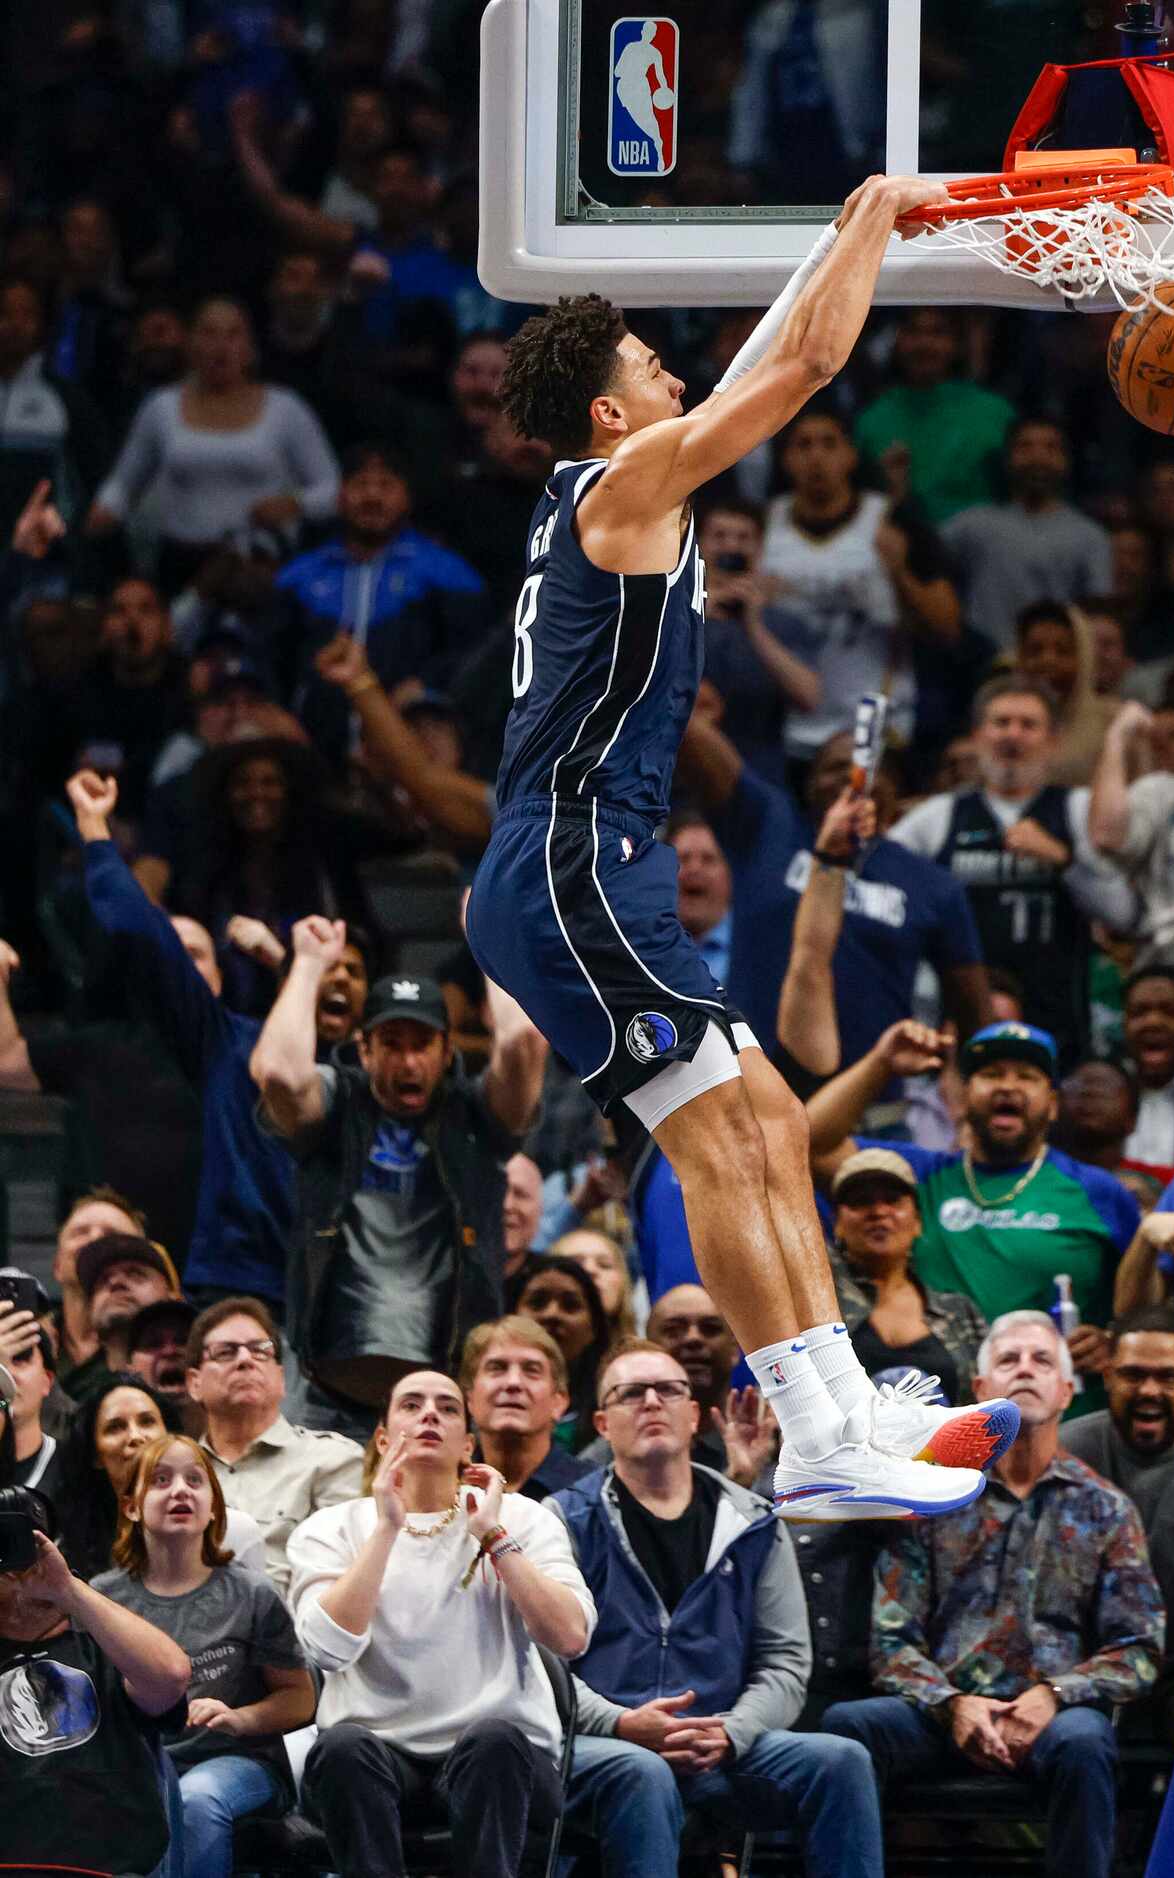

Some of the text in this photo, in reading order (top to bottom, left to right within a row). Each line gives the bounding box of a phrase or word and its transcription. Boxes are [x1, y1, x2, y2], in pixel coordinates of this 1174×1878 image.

[618, 140, 650, 165] NBA
[512, 574, 544, 698] 8
[191, 1645, 236, 1667] rothers
